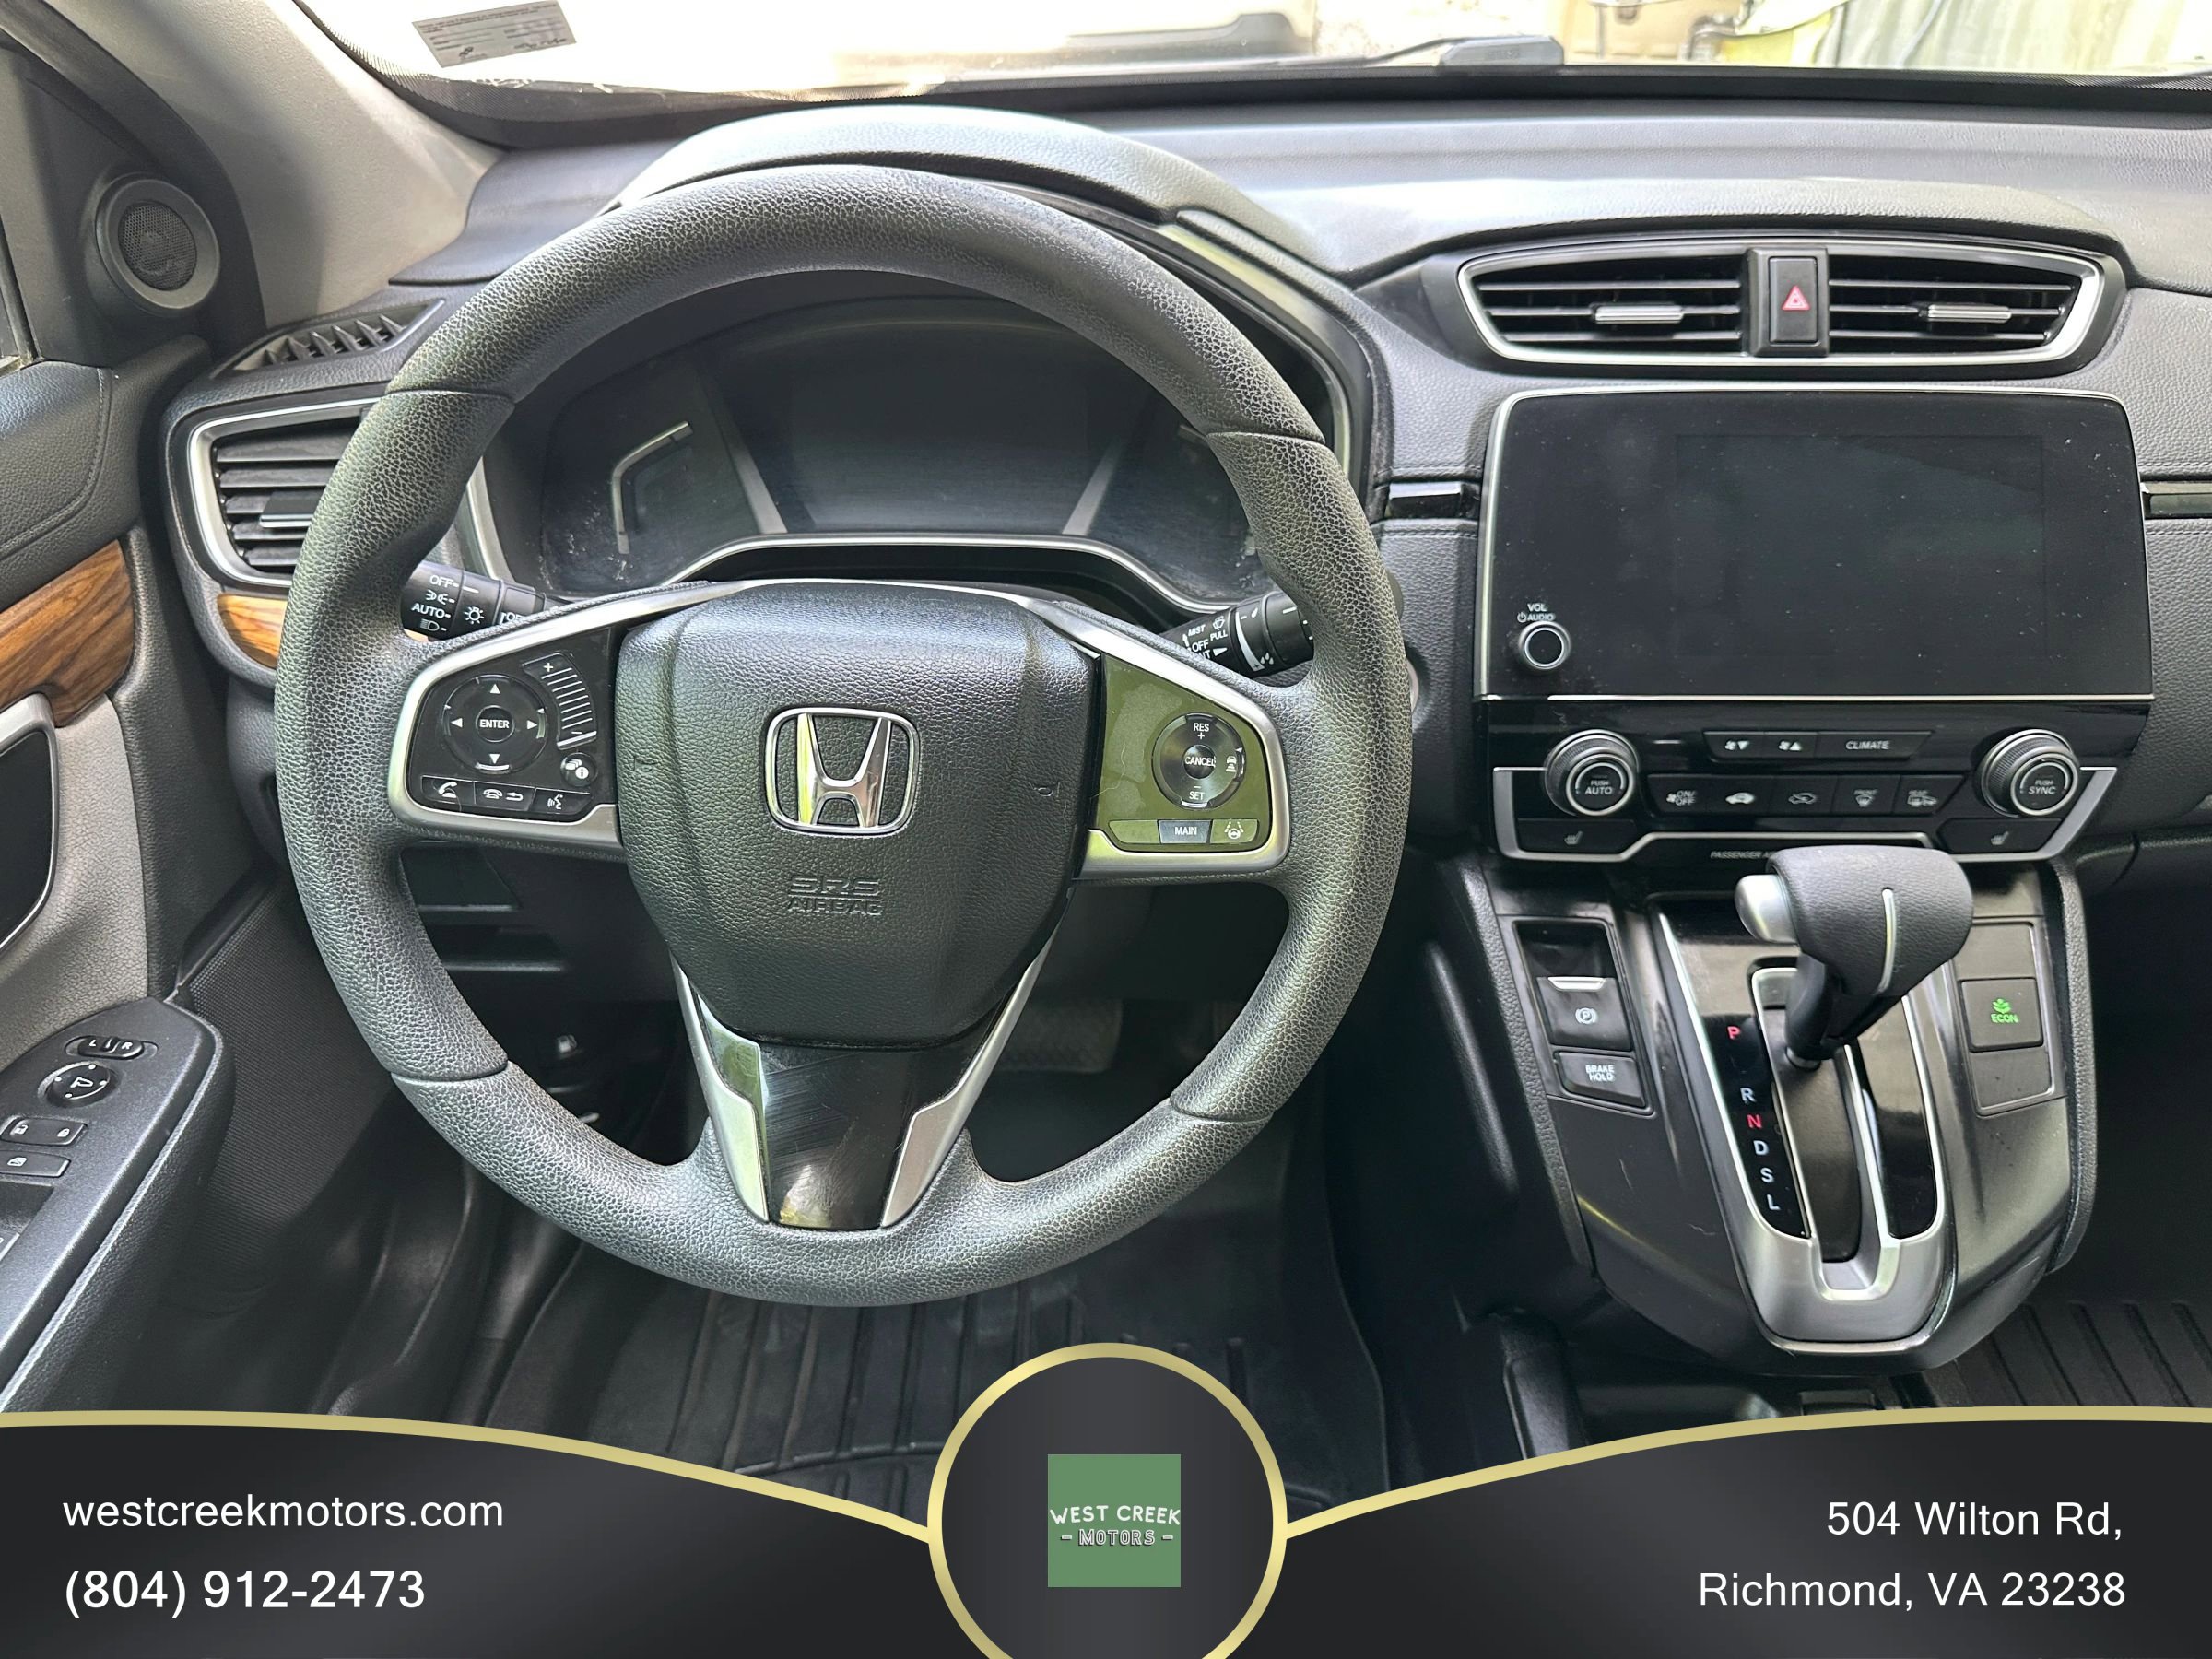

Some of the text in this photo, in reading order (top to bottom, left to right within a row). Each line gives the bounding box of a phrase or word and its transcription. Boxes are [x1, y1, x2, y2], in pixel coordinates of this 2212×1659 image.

[429, 574, 453, 588] OFF
[411, 603, 446, 619] AUTO
[1527, 603, 1547, 612] VOL
[1527, 613, 1556, 621] AUDIO
[1187, 623, 1206, 637] MIST
[1209, 631, 1229, 642] PULL
[1192, 639, 1209, 653] OFF
[479, 719, 510, 729] ENTER
[1193, 723, 1209, 732] RES
[1845, 740, 1889, 751] CLIMATE
[1184, 756, 1216, 768] CANCEL
[1189, 791, 1205, 801] SET
[1584, 786, 1613, 795] AUTO
[2028, 785, 2056, 796] SYNC
[1174, 826, 1197, 836] MAIN
[1991, 1013, 2019, 1023] ECON
[1727, 1026, 1741, 1040] P
[89, 1039, 134, 1050] L R
[1585, 1065, 1614, 1074] BRAKE
[1589, 1072, 1615, 1082] HOLD
[1740, 1088, 1756, 1102] R
[1747, 1114, 1762, 1128] N
[1753, 1140, 1769, 1155] D
[1760, 1168, 1774, 1183] S
[1767, 1194, 1781, 1211] L
